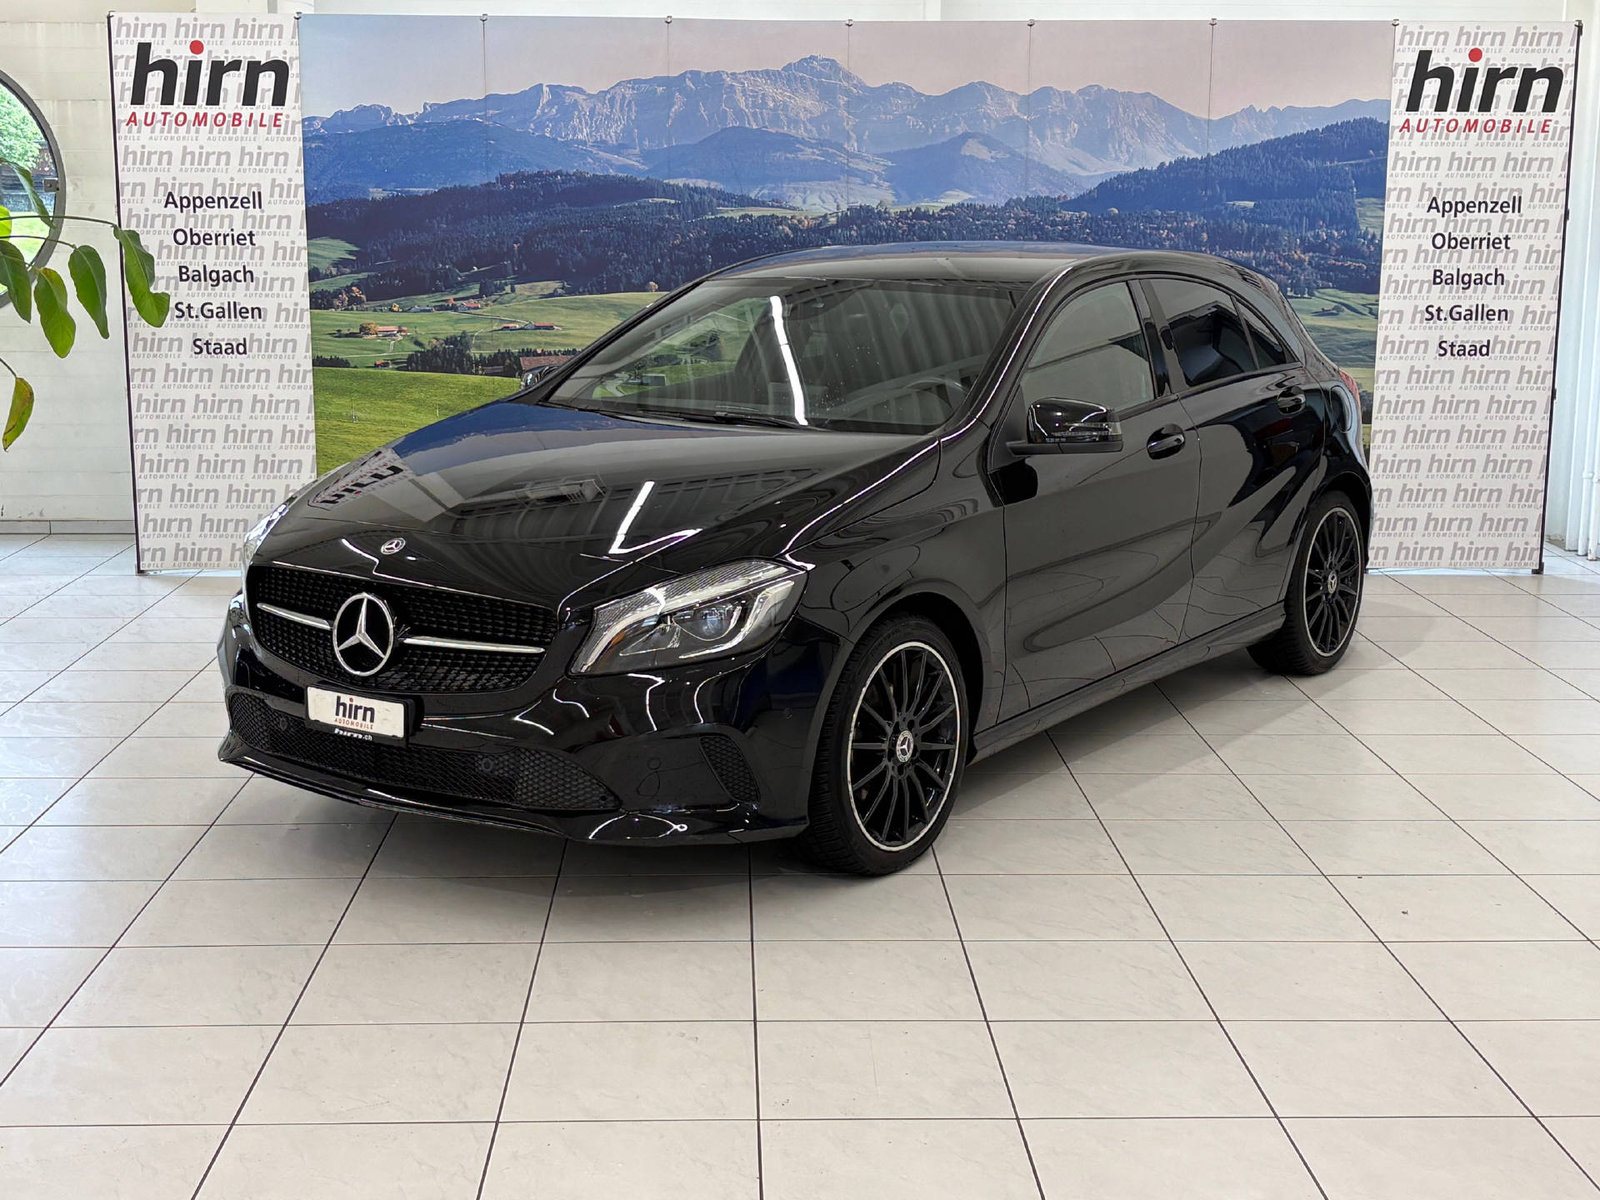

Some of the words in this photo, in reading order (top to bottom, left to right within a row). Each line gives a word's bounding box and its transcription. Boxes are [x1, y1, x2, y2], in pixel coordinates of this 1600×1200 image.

[131, 41, 289, 106] hirn
[1406, 49, 1563, 112] hirn
[127, 112, 281, 127] AUTOMOBILE
[1400, 119, 1550, 133] AUTOMOBILE
[164, 191, 261, 213] Appenzell
[1427, 196, 1521, 217] Appenzell
[174, 228, 255, 246] Oberriet
[1432, 232, 1510, 249] Oberriet
[179, 265, 253, 287] Balgach
[1433, 268, 1504, 290] Balgach
[175, 301, 261, 319] St.Gallen
[1425, 304, 1508, 321] St.Gallen
[193, 338, 247, 355] Staad
[1439, 340, 1490, 356] Staad
[278, 363, 311, 383] hir
[1517, 364, 1552, 384] hir
[280, 423, 314, 444] hir
[1512, 424, 1548, 444] hir
[1508, 483, 1544, 503] hir
[1504, 541, 1540, 561] hir
[335, 696, 375, 723] hirn
[335, 718, 374, 730] AUTOMOBILE
